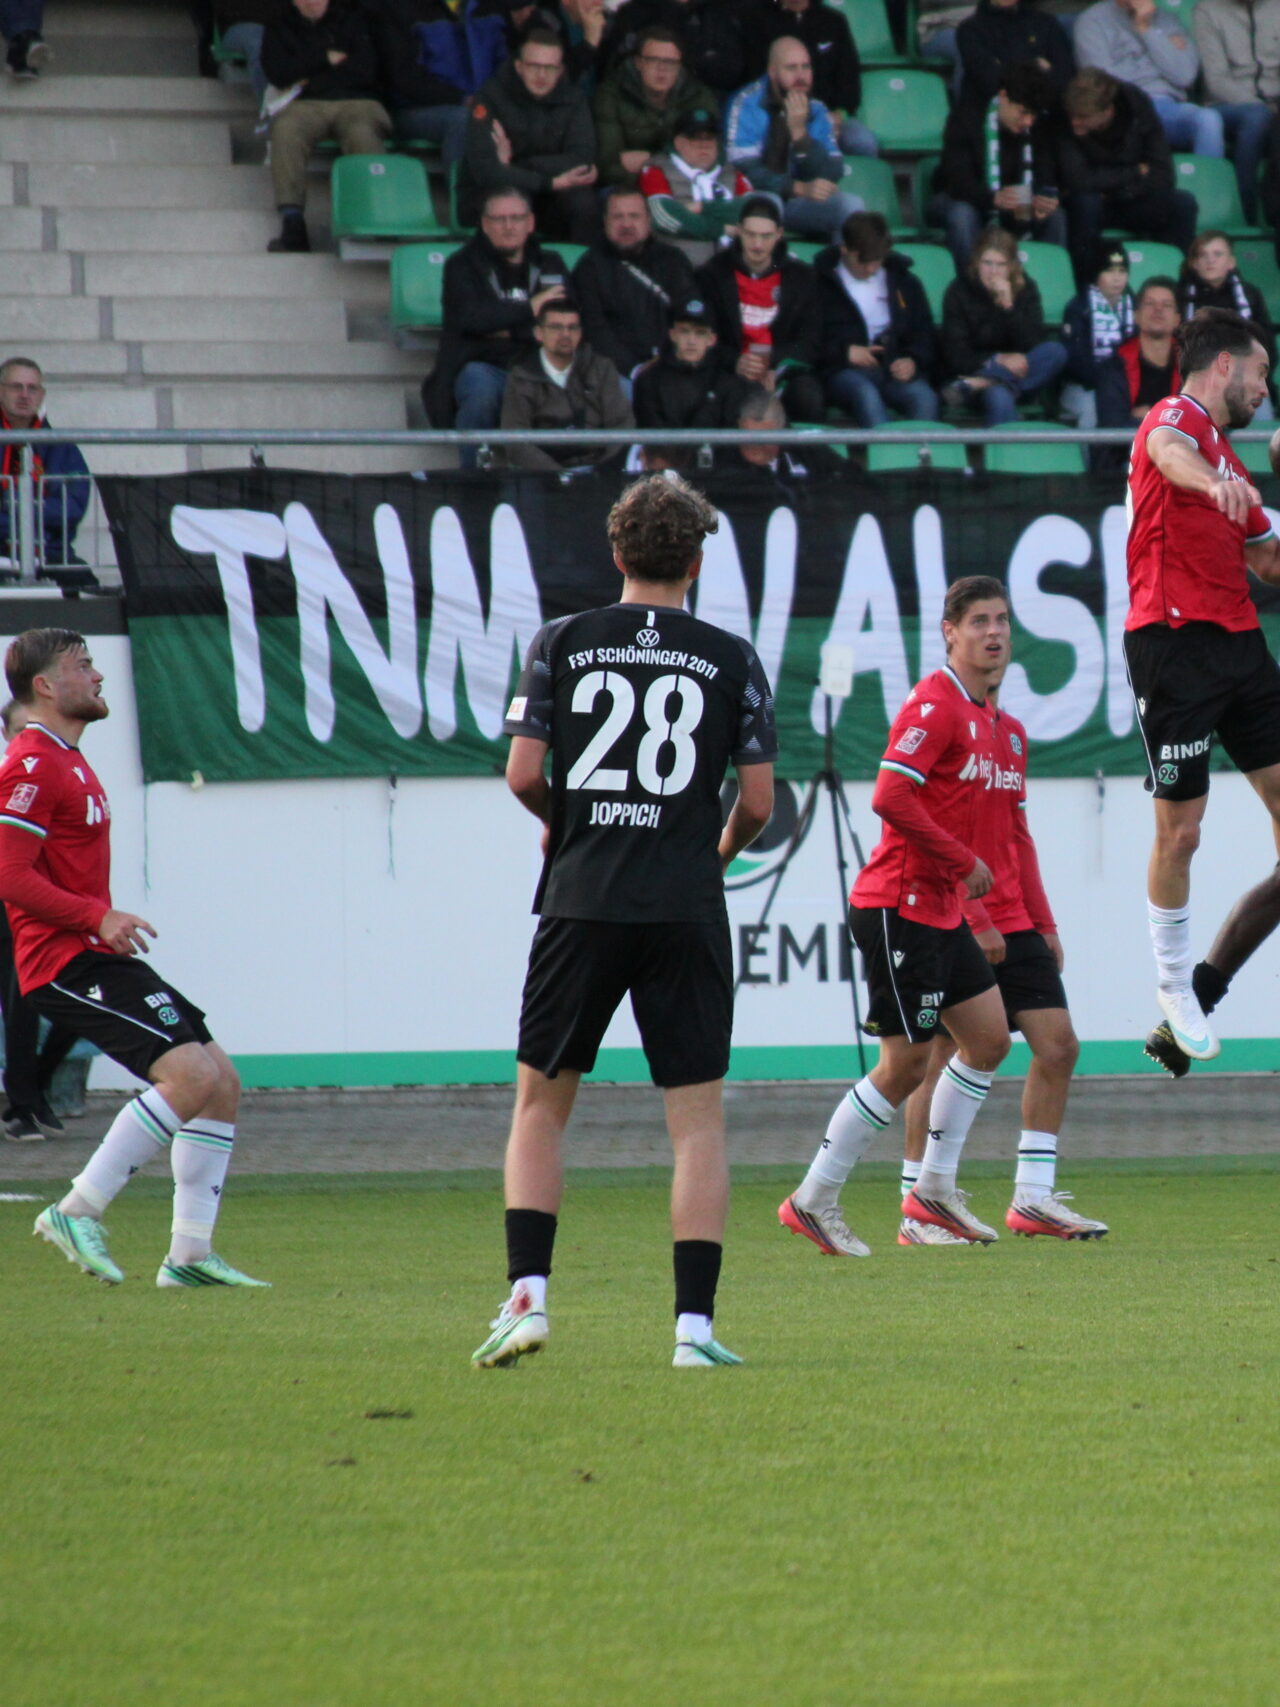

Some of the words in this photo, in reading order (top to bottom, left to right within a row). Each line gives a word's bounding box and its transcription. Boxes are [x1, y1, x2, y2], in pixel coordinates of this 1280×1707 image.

[171, 501, 544, 743] TNM
[567, 648, 594, 670] FSV
[596, 645, 689, 668] SCHÖNINGEN
[686, 655, 719, 681] 2011
[565, 670, 705, 796] 28
[1159, 765, 1178, 782] 96
[588, 801, 662, 829] JOPPICH
[918, 1011, 937, 1026] 96
